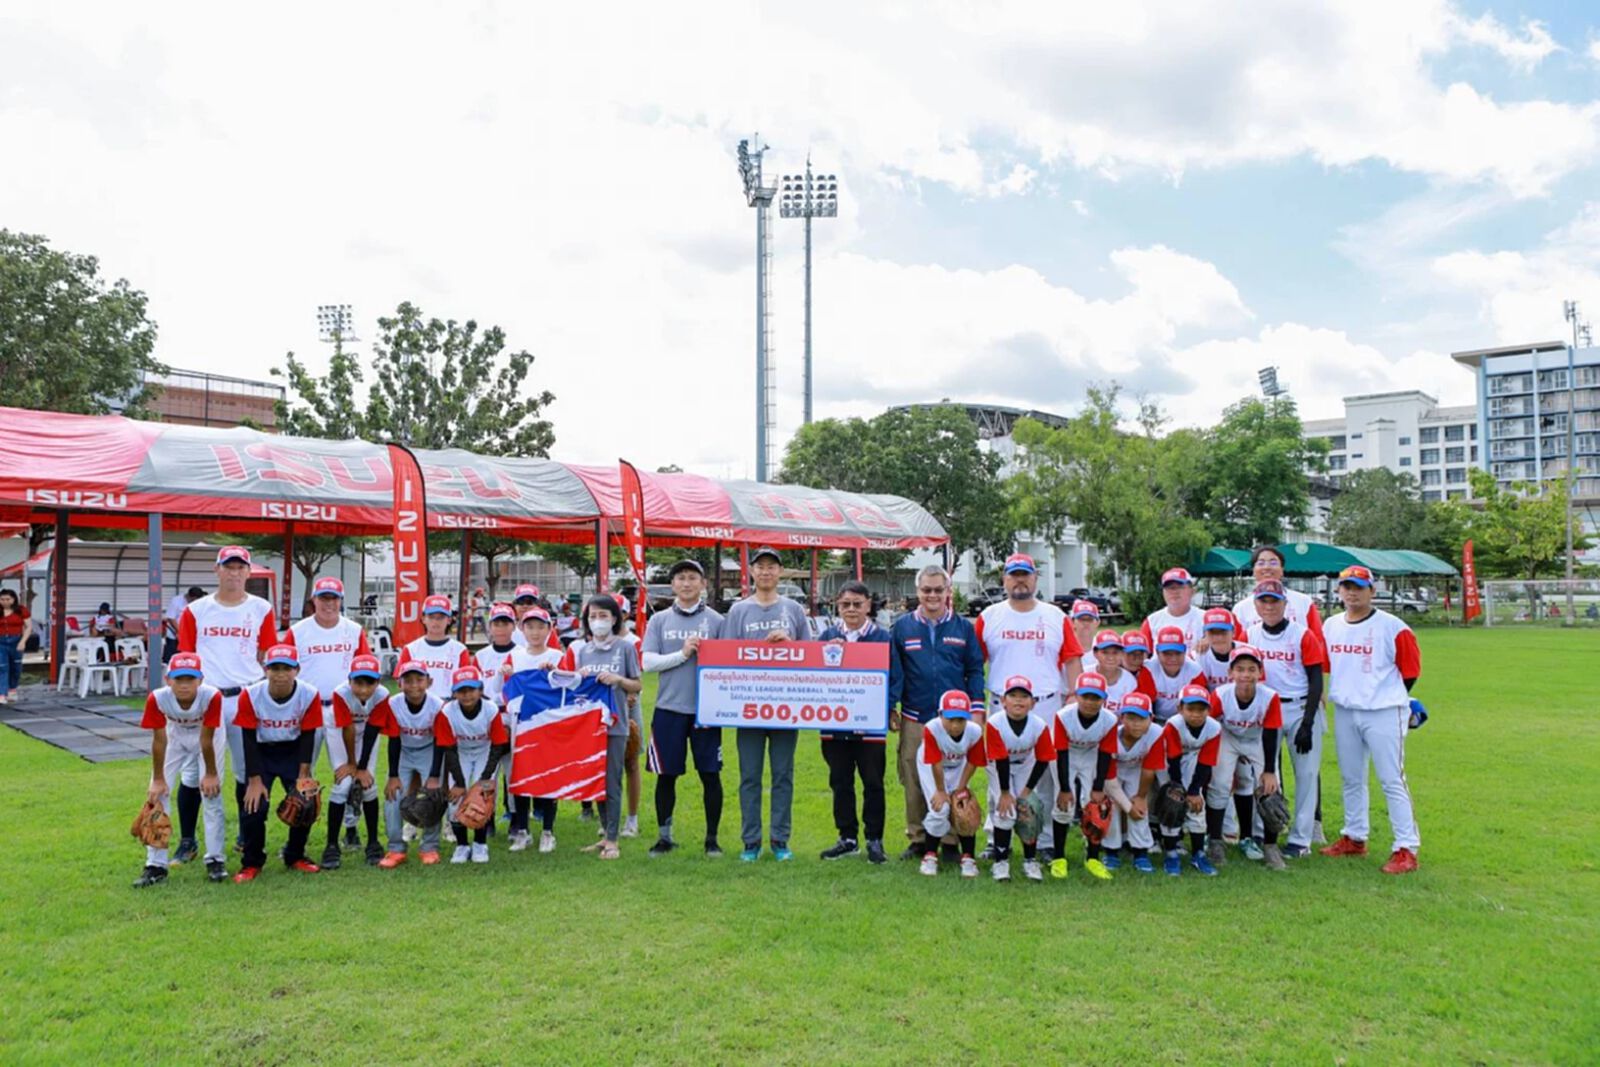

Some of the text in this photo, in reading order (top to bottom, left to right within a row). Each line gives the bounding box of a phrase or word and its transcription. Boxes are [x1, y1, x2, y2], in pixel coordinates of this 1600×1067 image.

[26, 488, 127, 508] ISUZU
[260, 501, 338, 520] ISUZU
[437, 515, 498, 528] ISUZU
[690, 525, 735, 538] ISUZU
[788, 534, 823, 546] ISUZU
[203, 626, 252, 638] ISUZU
[745, 619, 790, 633] ISUZU
[1002, 629, 1045, 641] ISUZU
[307, 642, 352, 655] ISUZU
[737, 646, 805, 661] ISUZU
[1330, 643, 1373, 655] ISUZU
[1260, 649, 1296, 662] SUZU
[425, 659, 454, 670] UZU
[861, 675, 883, 685] 2023
[787, 687, 823, 695] BASEBALL
[742, 703, 849, 724] 500,000
